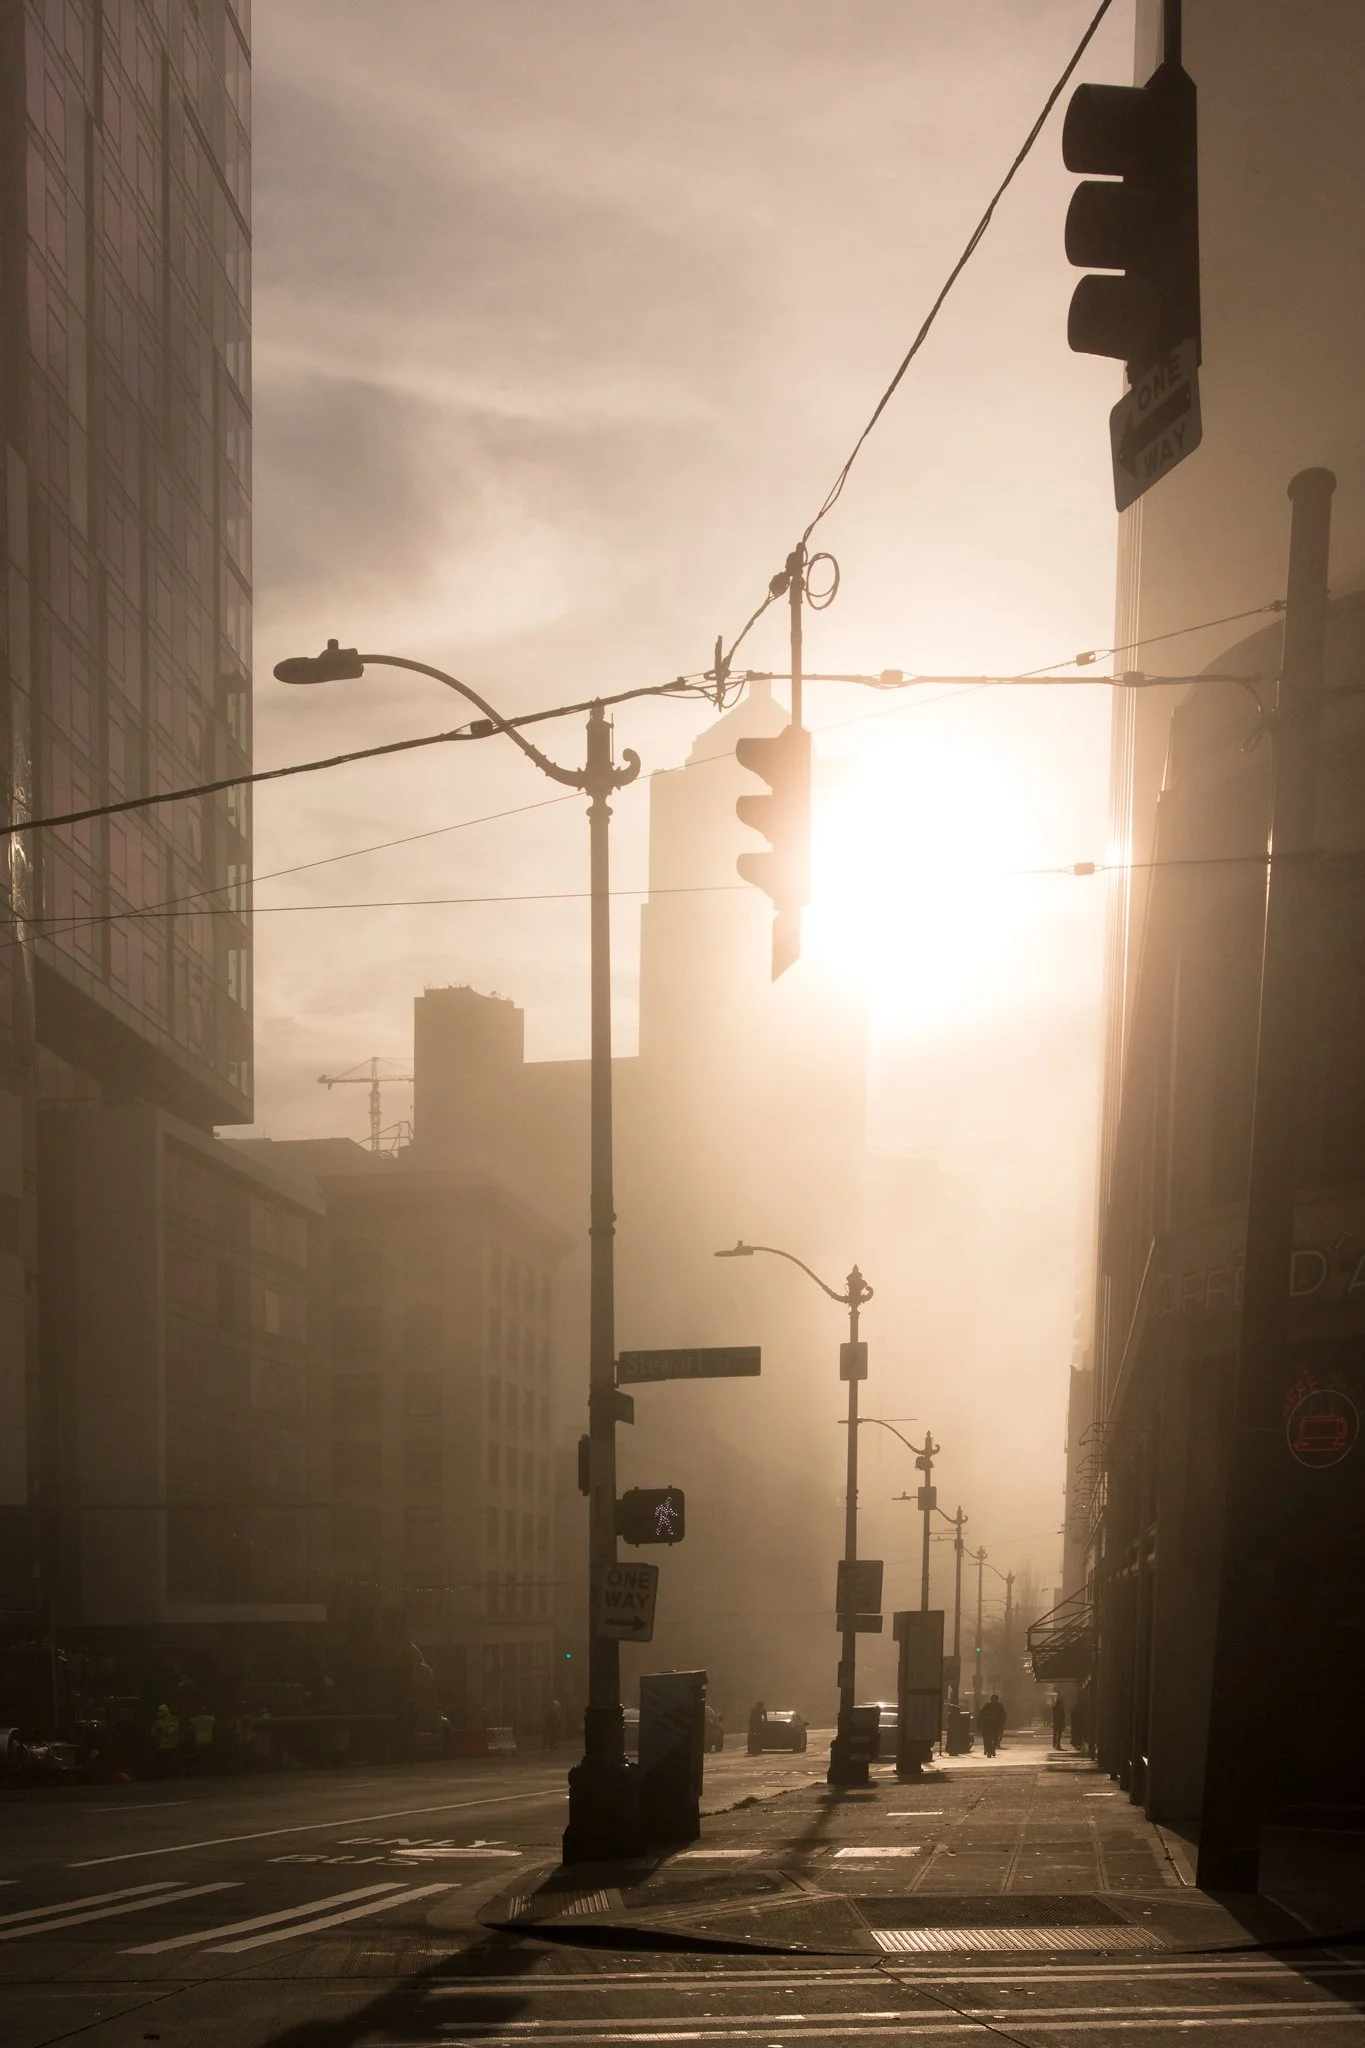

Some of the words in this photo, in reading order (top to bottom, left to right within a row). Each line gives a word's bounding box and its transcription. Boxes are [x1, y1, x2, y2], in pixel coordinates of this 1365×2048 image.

[1137, 355, 1181, 411] ONE
[1144, 421, 1186, 478] WAY
[1154, 1260, 1245, 1316] AFF
[626, 1351, 704, 1375] Stewart
[607, 1569, 650, 1589] ONE
[605, 1590, 650, 1609] WAY
[336, 1837, 509, 1847] ONLY
[266, 1854, 434, 1865] BUS
